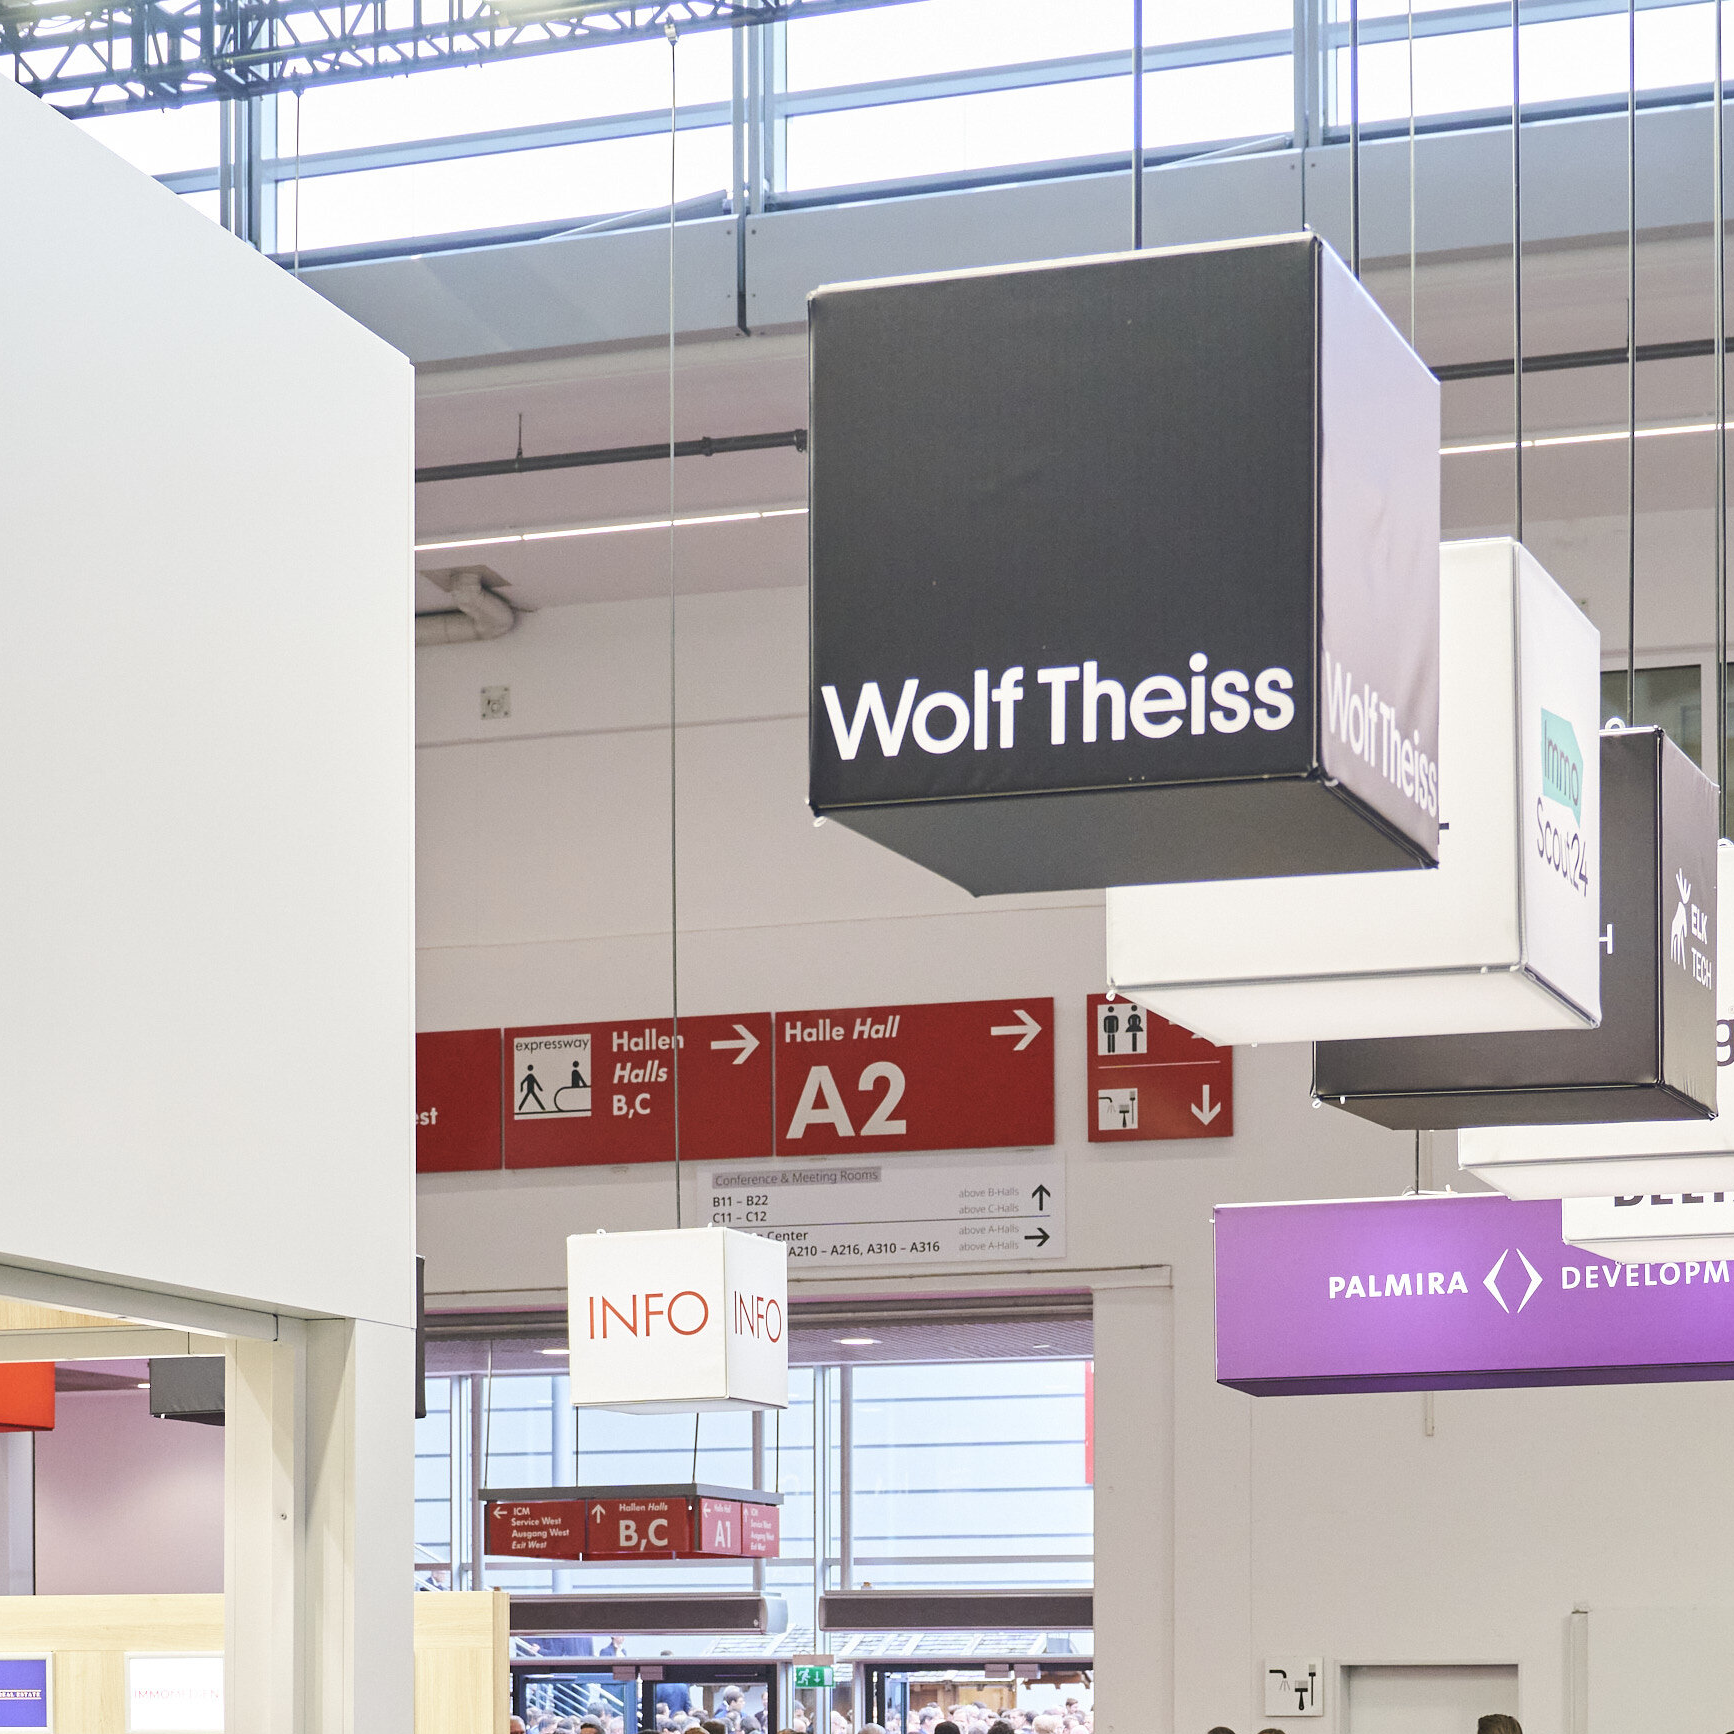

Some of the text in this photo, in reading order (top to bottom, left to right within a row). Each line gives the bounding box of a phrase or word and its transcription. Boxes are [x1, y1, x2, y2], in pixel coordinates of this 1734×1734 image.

[821, 652, 1294, 760] Wolf Theiss
[1326, 651, 1439, 818] Wolf Theiss
[1543, 720, 1579, 807] Immo
[1536, 796, 1588, 897] Scout24
[1691, 903, 1708, 945] ELK
[1691, 947, 1712, 990] TECH
[612, 1028, 684, 1052] Hallen
[785, 1016, 901, 1043] Halle Hall
[515, 1037, 590, 1054] expressway
[613, 1060, 668, 1084] Halls
[612, 1093, 651, 1119] B,C
[786, 1061, 907, 1139] A2
[416, 1107, 438, 1126] st
[716, 1168, 878, 1187] Conference & Meeting Rooms
[713, 1196, 733, 1208] B11
[746, 1195, 769, 1206] B22
[958, 1188, 985, 1198] above
[713, 1211, 733, 1223] C11
[746, 1210, 767, 1222] C12
[958, 1204, 985, 1214] above
[767, 1230, 808, 1242] Center
[958, 1225, 985, 1235] above
[788, 1245, 817, 1258] A210
[830, 1243, 864, 1258] A216,
[867, 1241, 897, 1255] A310
[910, 1240, 940, 1253] A316
[1329, 1271, 1468, 1299] PALMIRA
[589, 1290, 709, 1339] INFO
[734, 1290, 782, 1343] INFO
[513, 1507, 530, 1516] ICM
[619, 1502, 668, 1512] Hallen Halls
[511, 1517, 562, 1527] Service West
[511, 1528, 570, 1540] Ausgang West
[714, 1520, 731, 1548] A1
[529, 1541, 547, 1549] West
[618, 1519, 669, 1551] B,C
